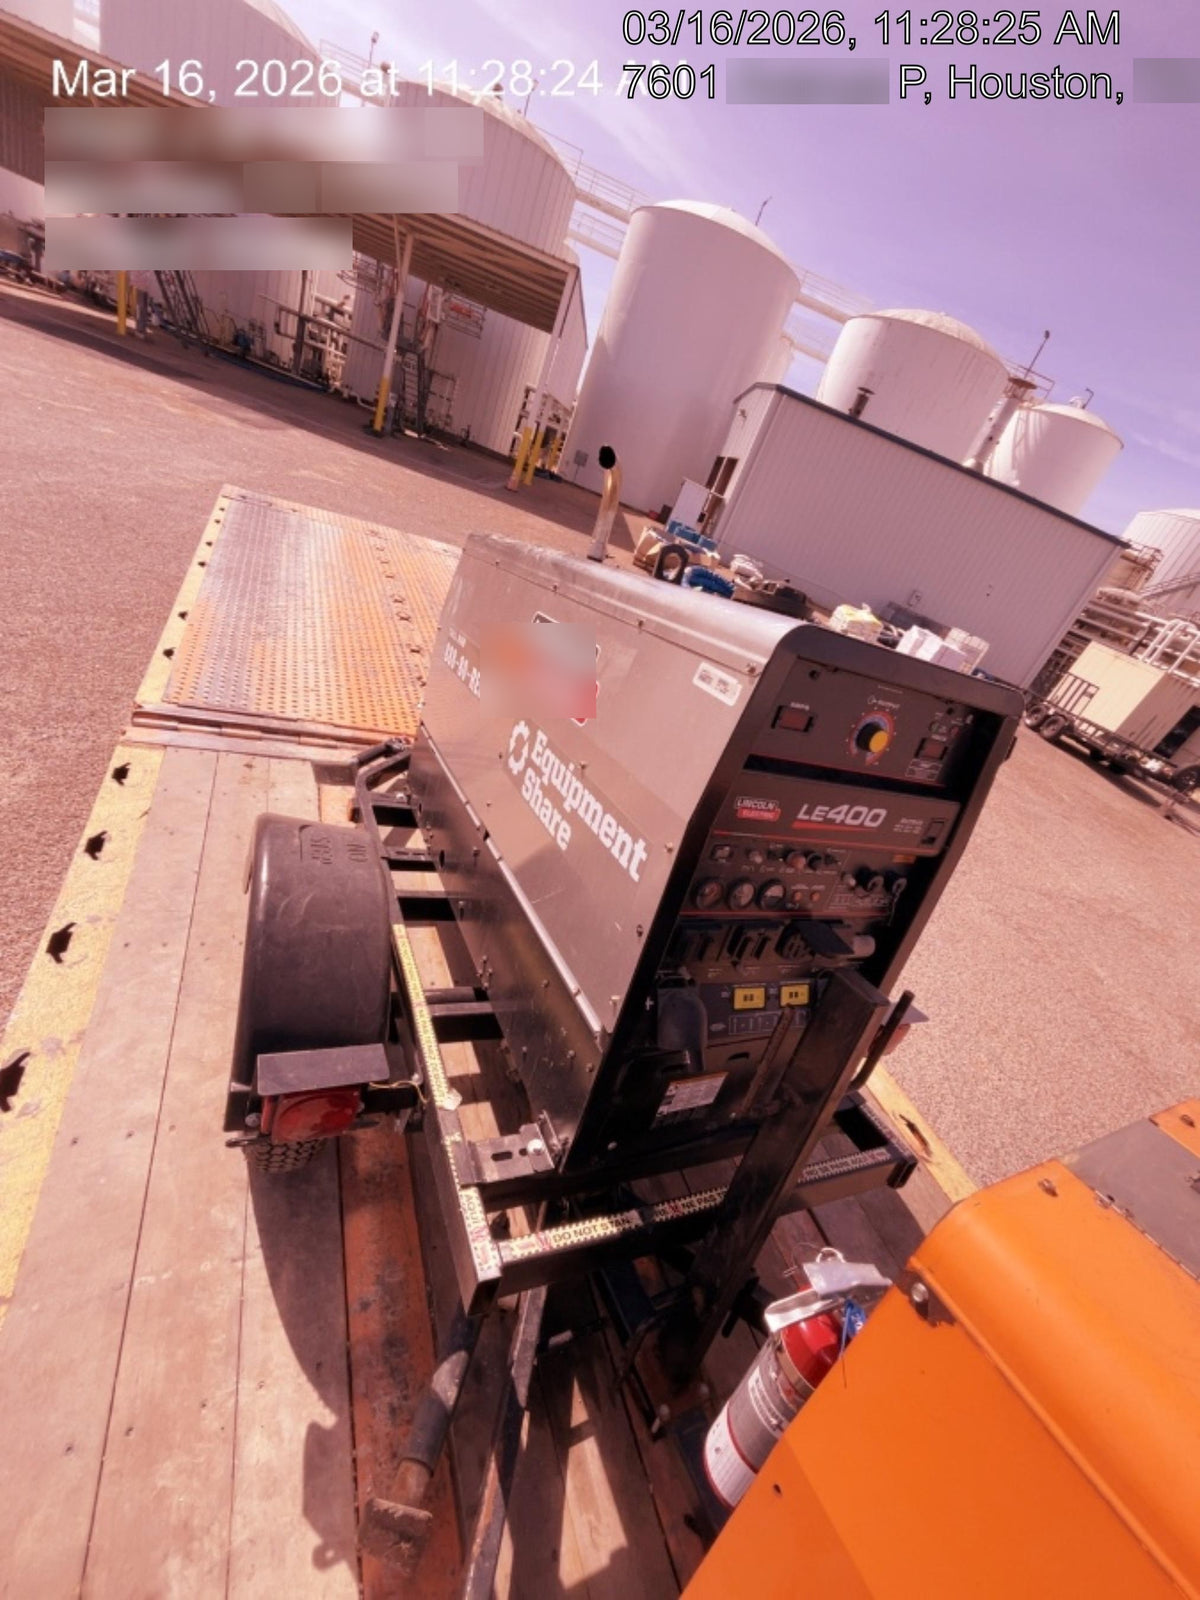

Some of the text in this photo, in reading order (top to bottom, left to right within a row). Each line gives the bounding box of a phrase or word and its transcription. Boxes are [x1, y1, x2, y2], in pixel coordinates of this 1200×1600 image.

[522, 767, 571, 851] Share
[531, 730, 647, 882] Equipment
[797, 804, 887, 828] LE400
[552, 1231, 571, 1242] DO
[573, 1224, 598, 1237] NOT
